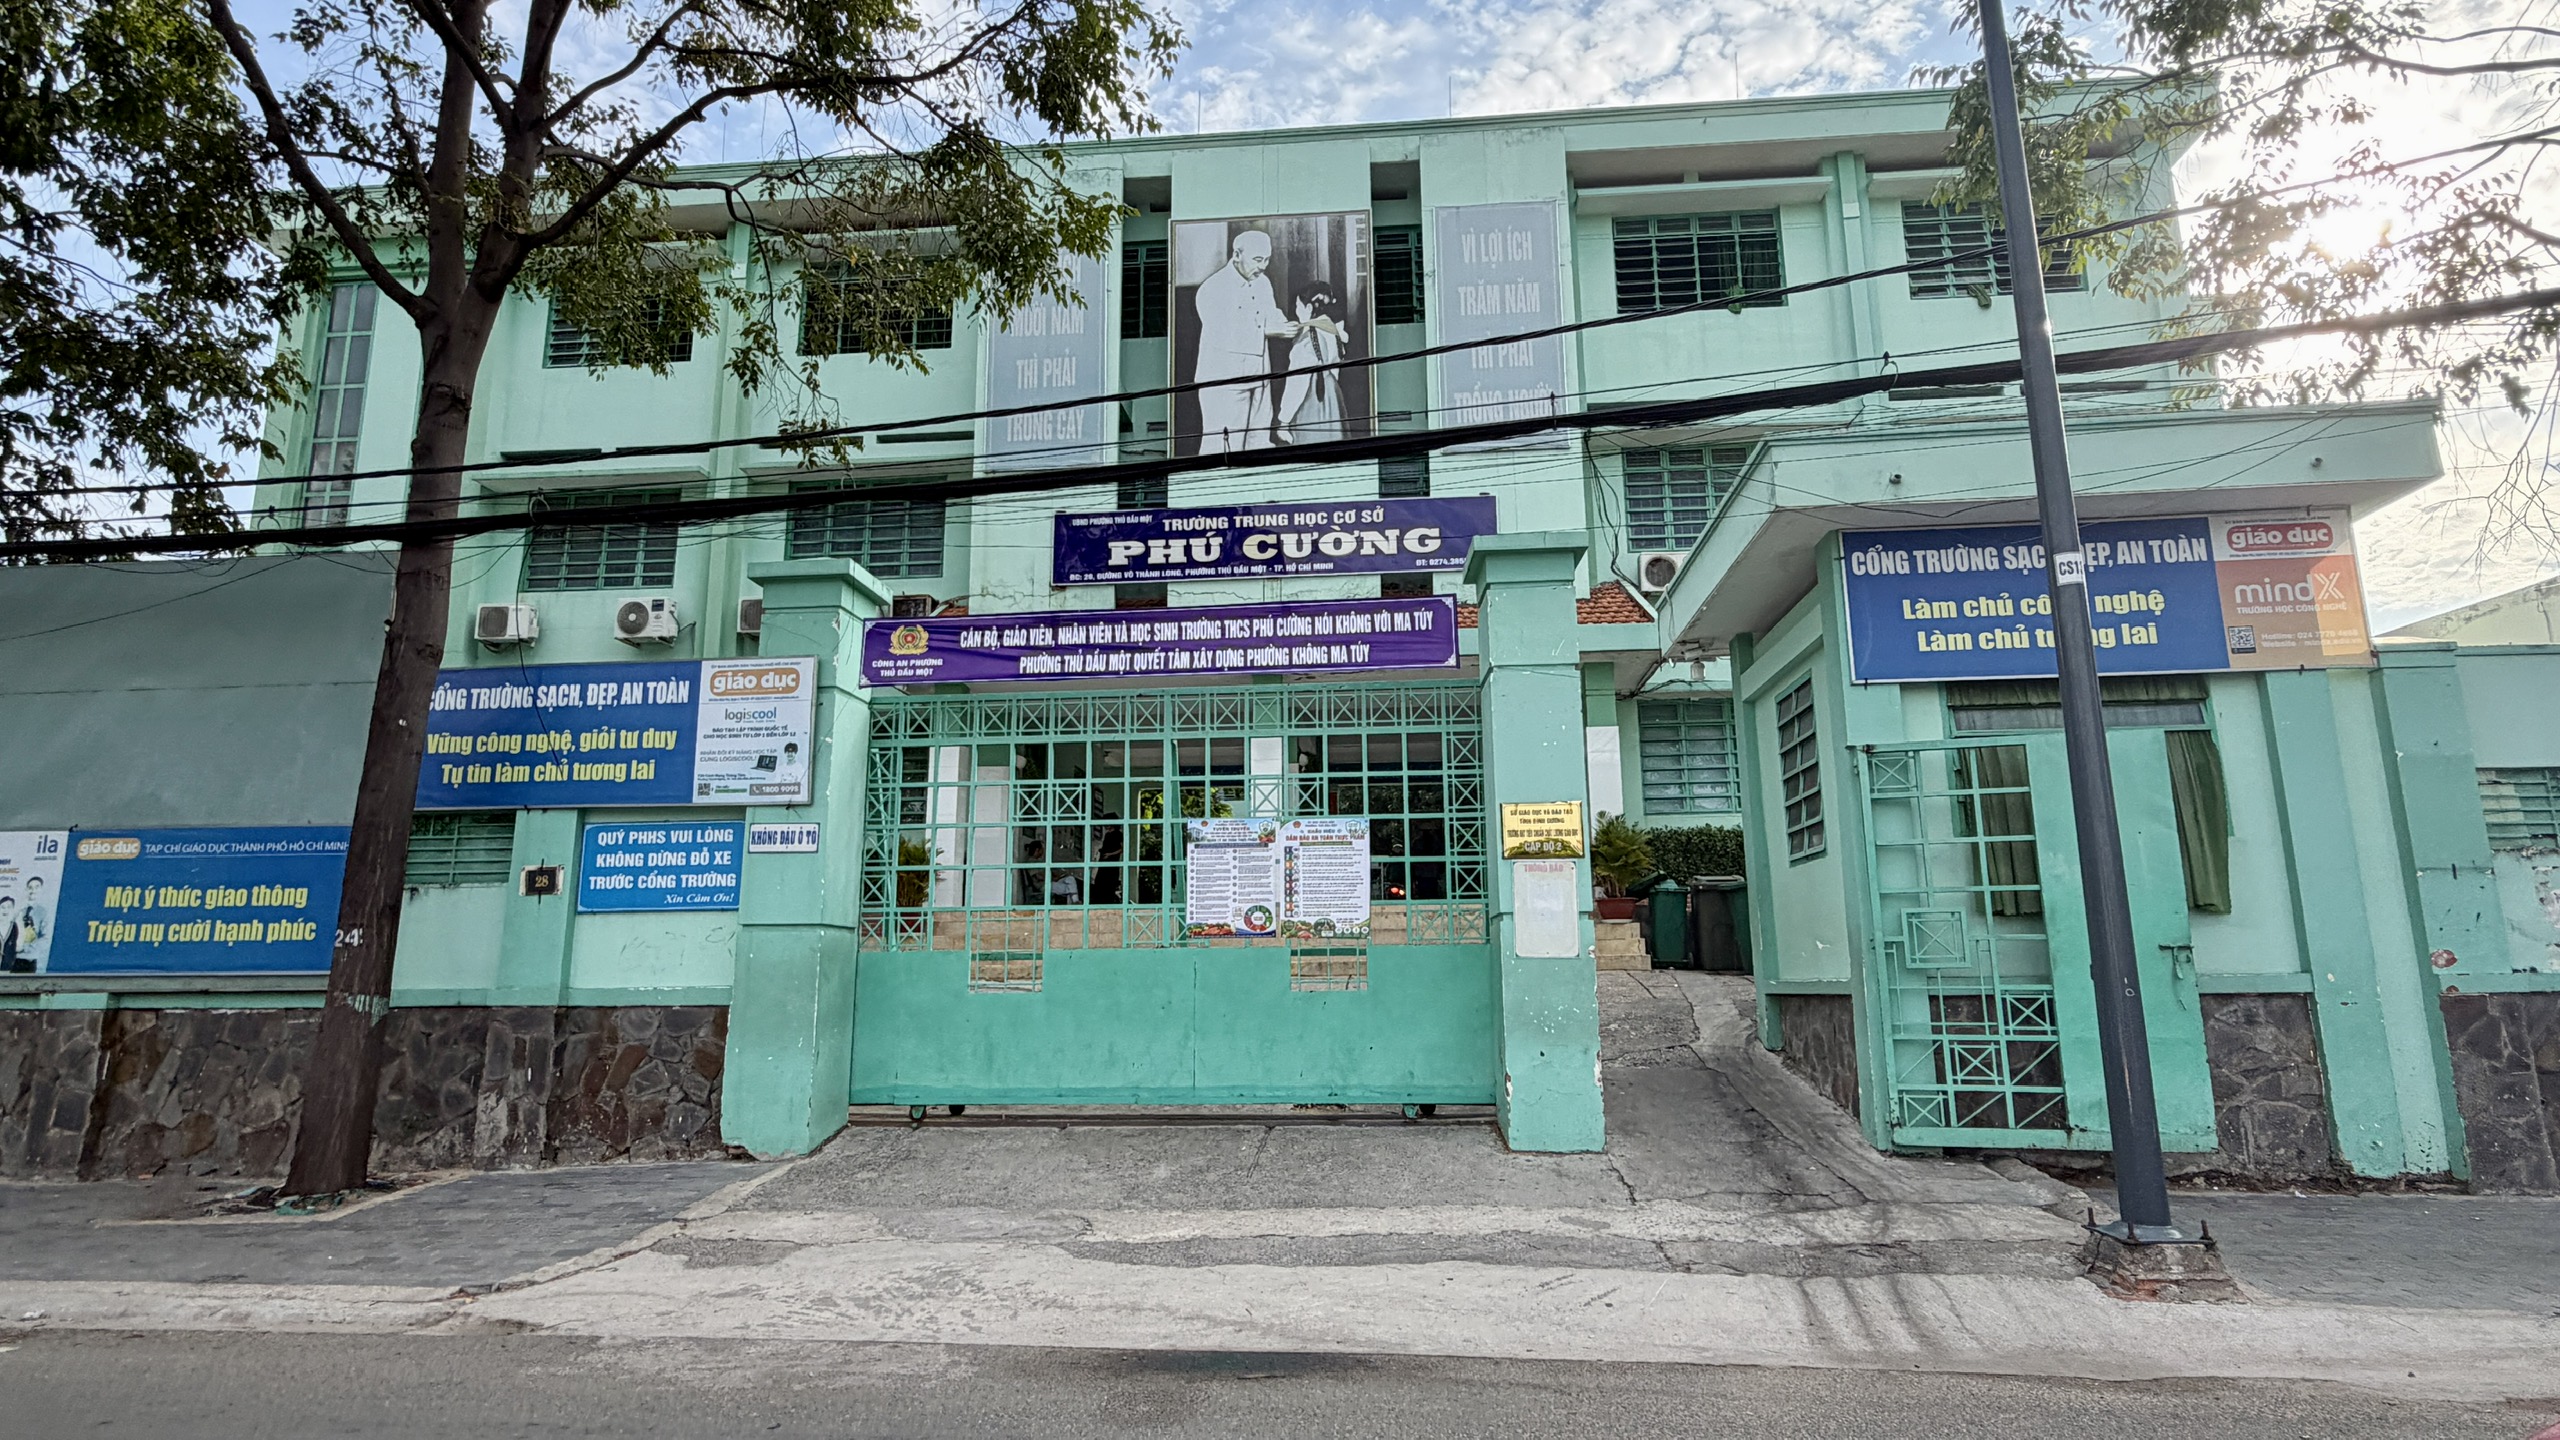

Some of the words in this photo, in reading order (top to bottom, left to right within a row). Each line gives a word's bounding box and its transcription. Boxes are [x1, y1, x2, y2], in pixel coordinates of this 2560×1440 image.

[1462, 228, 1476, 263] VÌ
[1480, 229, 1503, 268] LỢI
[1507, 225, 1533, 262] ÍCH
[1458, 280, 1499, 316] TRĂM
[1505, 277, 1540, 314] NĂM
[1016, 353, 1037, 389] THÌ
[1043, 349, 1076, 387] PHẢI
[1163, 515, 1228, 531] TRƯỜNG
[1233, 514, 1288, 528] TRUNG
[1294, 512, 1328, 527] HỌC
[1334, 509, 1356, 523] CƠ
[1361, 505, 1384, 523] SỞ
[1108, 531, 1223, 565] PHÚ
[1243, 526, 1441, 560] CƯỜNG
[2232, 527, 2282, 548] giáo
[2287, 527, 2329, 545] dục
[1852, 545, 1910, 575] CỔNG
[1913, 544, 2000, 573] TRƯỜNG
[2117, 541, 2146, 565] AN
[2149, 534, 2207, 563] TOÀN
[2235, 572, 2344, 604] mindX
[1903, 598, 1957, 619] Làm
[1963, 593, 2013, 617] chủ
[2095, 589, 2165, 615] nghệ
[2275, 606, 2294, 614] HỌC
[960, 627, 982, 648] CÁN
[984, 625, 1000, 650] BỘ,
[1003, 625, 1027, 646] GIÁO
[1030, 624, 1055, 647] VIÊN,
[1058, 622, 1086, 645] NHÂN
[1089, 622, 1112, 643] VIÊN
[1115, 620, 1128, 642] VÀ
[1130, 623, 1151, 646] HỌC
[1154, 622, 1178, 641] SINH
[1181, 617, 1221, 640] TRƯỜNG
[1224, 619, 1250, 638] THCS
[1253, 614, 1273, 637] PHÚ
[1277, 613, 1311, 635] CƯỜNG
[1315, 612, 1332, 635] NÓI
[1336, 611, 1371, 634] KHÔNG
[1374, 610, 1391, 632] VỚI
[1394, 612, 1411, 631] MA
[1414, 608, 1433, 630] TÚY
[1918, 630, 1972, 652] Làm
[1978, 624, 2030, 649] chủ
[2121, 622, 2158, 645] lai
[1020, 652, 1061, 674] PHƯỜNG
[1064, 649, 1083, 672] THỦ
[1086, 648, 1106, 672] DẦU
[1109, 650, 1131, 674] MỘT
[1134, 647, 1165, 672] QUYẾT
[1168, 648, 1190, 669] TÂM
[1193, 647, 1213, 668] XÂY
[1216, 648, 1244, 671] DỰNG
[1247, 644, 1289, 666] PHƯỜNG
[1292, 643, 1328, 665] KHÔNG
[1331, 645, 1348, 663] MA
[1350, 641, 1369, 662] TÚY
[713, 672, 757, 693] giáo
[761, 672, 796, 691] dục
[916, 668, 933, 676] MỘT
[471, 682, 534, 709] TRƯỜNG
[536, 683, 583, 712] SẠCH,
[587, 682, 618, 710] ĐẸP,
[621, 682, 643, 704] AN
[647, 676, 689, 704] TOÀN
[725, 707, 776, 722] logiscool
[427, 732, 473, 755] Vững
[476, 732, 522, 754] công
[525, 730, 575, 755] nghệ,
[580, 726, 616, 752] giỏi
[620, 730, 639, 749] tư
[643, 728, 677, 750] duy
[442, 764, 464, 788] Tự
[467, 763, 491, 783] tin
[495, 762, 530, 783] làm
[534, 758, 569, 781] chủ
[573, 762, 627, 782] tương
[631, 759, 655, 780] lai
[37, 835, 58, 853] ila
[80, 840, 110, 856] giáo
[113, 841, 138, 854] dục
[145, 844, 163, 854] TẠP
[164, 842, 180, 852] CHÍ
[182, 842, 206, 852] GIÁO
[208, 843, 229, 854] DỤC
[232, 842, 265, 852] THÀNH
[266, 840, 287, 851] PHỐ
[290, 840, 304, 850] HỒ
[306, 840, 323, 850] CHÍ
[598, 830, 625, 846] QUÝ
[629, 831, 666, 844] PHHS
[670, 830, 692, 843] VUI
[696, 826, 733, 843] LÒNG
[751, 827, 778, 845] KHÔNG
[806, 827, 817, 845] TÔ
[596, 851, 644, 867] KHÔNG
[648, 850, 687, 866] DỪNG
[690, 846, 709, 866] ĐỖ
[713, 851, 731, 865] XE
[535, 875, 549, 887] 28
[589, 873, 633, 890] TRƯỚC
[638, 870, 676, 889] CỔNG
[681, 871, 736, 888] TRƯỜNG
[105, 886, 141, 912] Một
[143, 885, 155, 909] ý
[159, 885, 202, 907] thức
[205, 885, 248, 909] giao
[251, 884, 308, 908] thông
[664, 895, 683, 904] Xin
[686, 894, 710, 903] Cảm
[713, 893, 734, 902] Ơn!
[88, 920, 136, 947] Triệu
[139, 923, 165, 947] nụ
[168, 919, 212, 942] cười
[214, 919, 264, 946] hạnh
[266, 918, 316, 943] phúc
